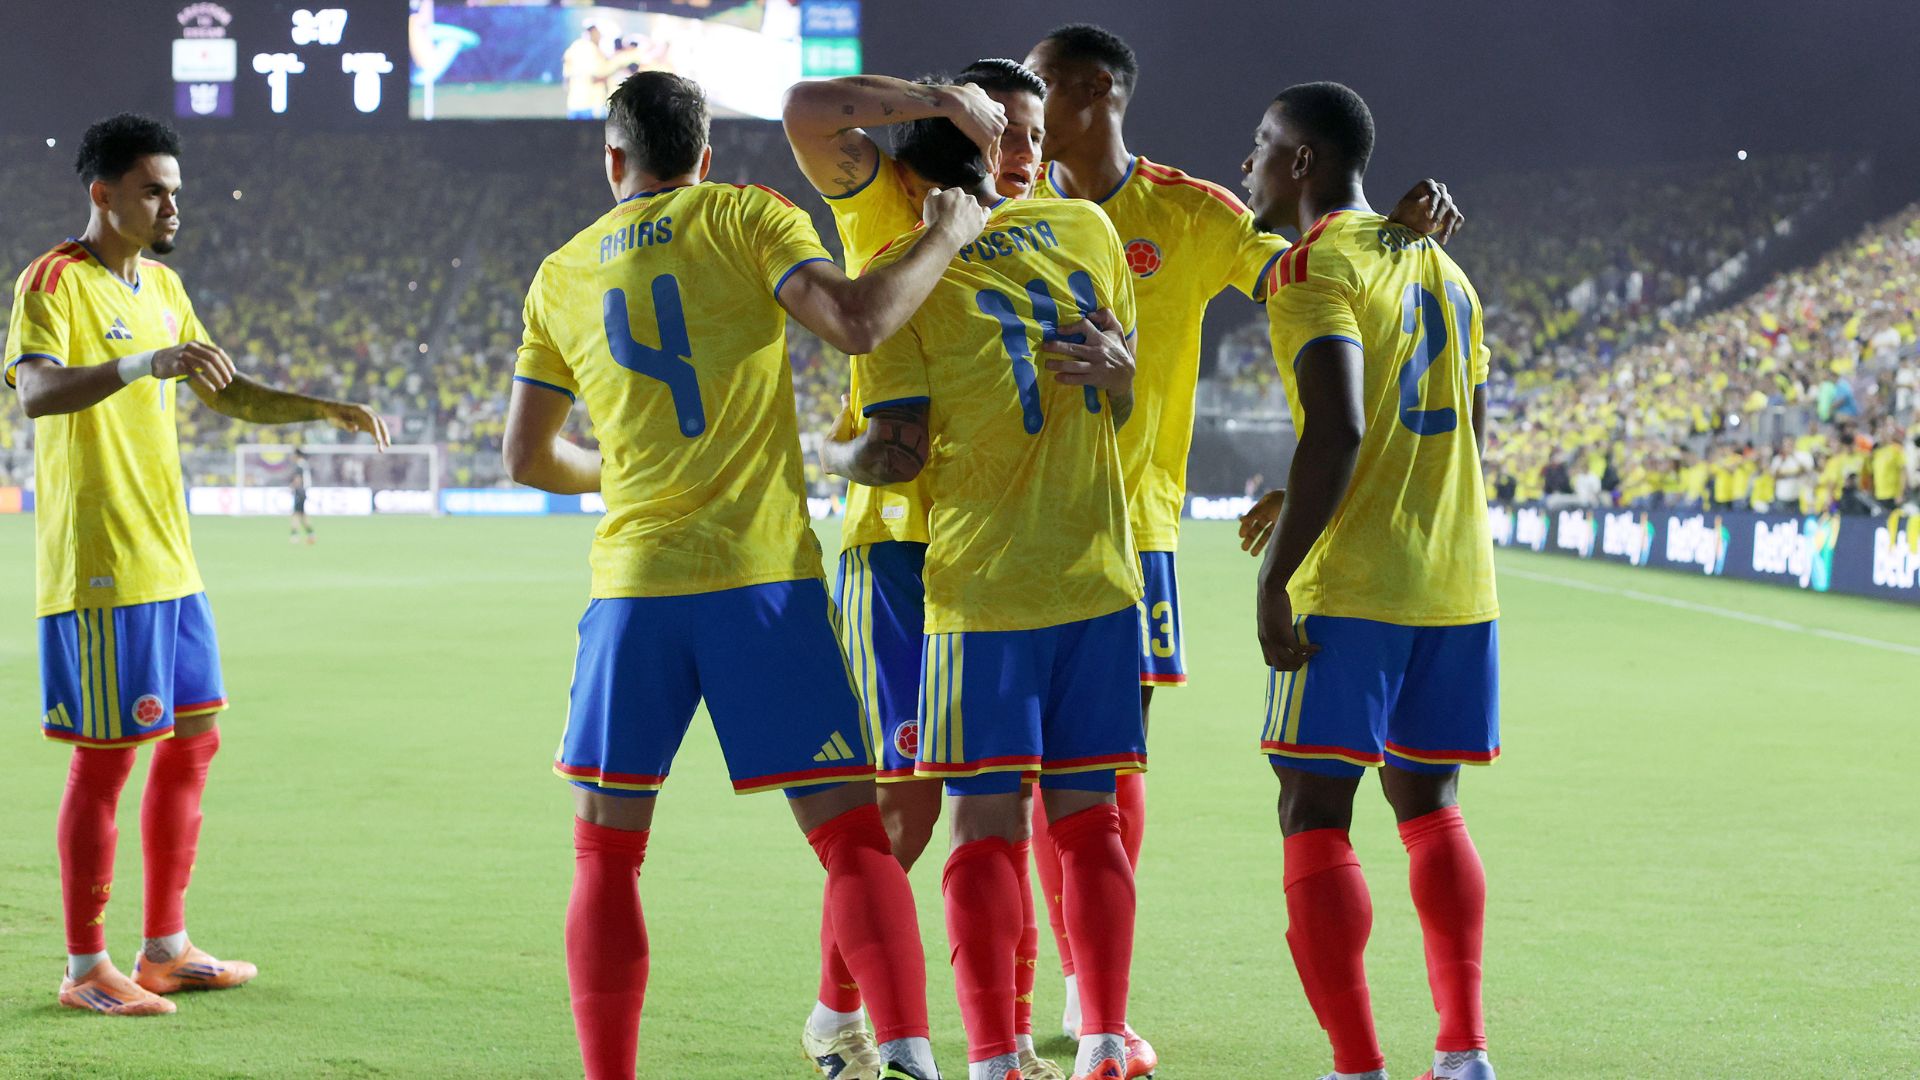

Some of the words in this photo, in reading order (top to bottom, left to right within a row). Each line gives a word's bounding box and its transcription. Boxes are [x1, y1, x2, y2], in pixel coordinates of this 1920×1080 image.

[267, 72, 288, 114] 1
[600, 216, 673, 264] ARIAS
[959, 220, 1058, 263] PUERTA
[603, 273, 706, 438] 4
[975, 270, 1101, 435] 14
[1399, 280, 1473, 436] 21
[1873, 527, 1920, 588] BetP
[1136, 600, 1175, 658] 13
